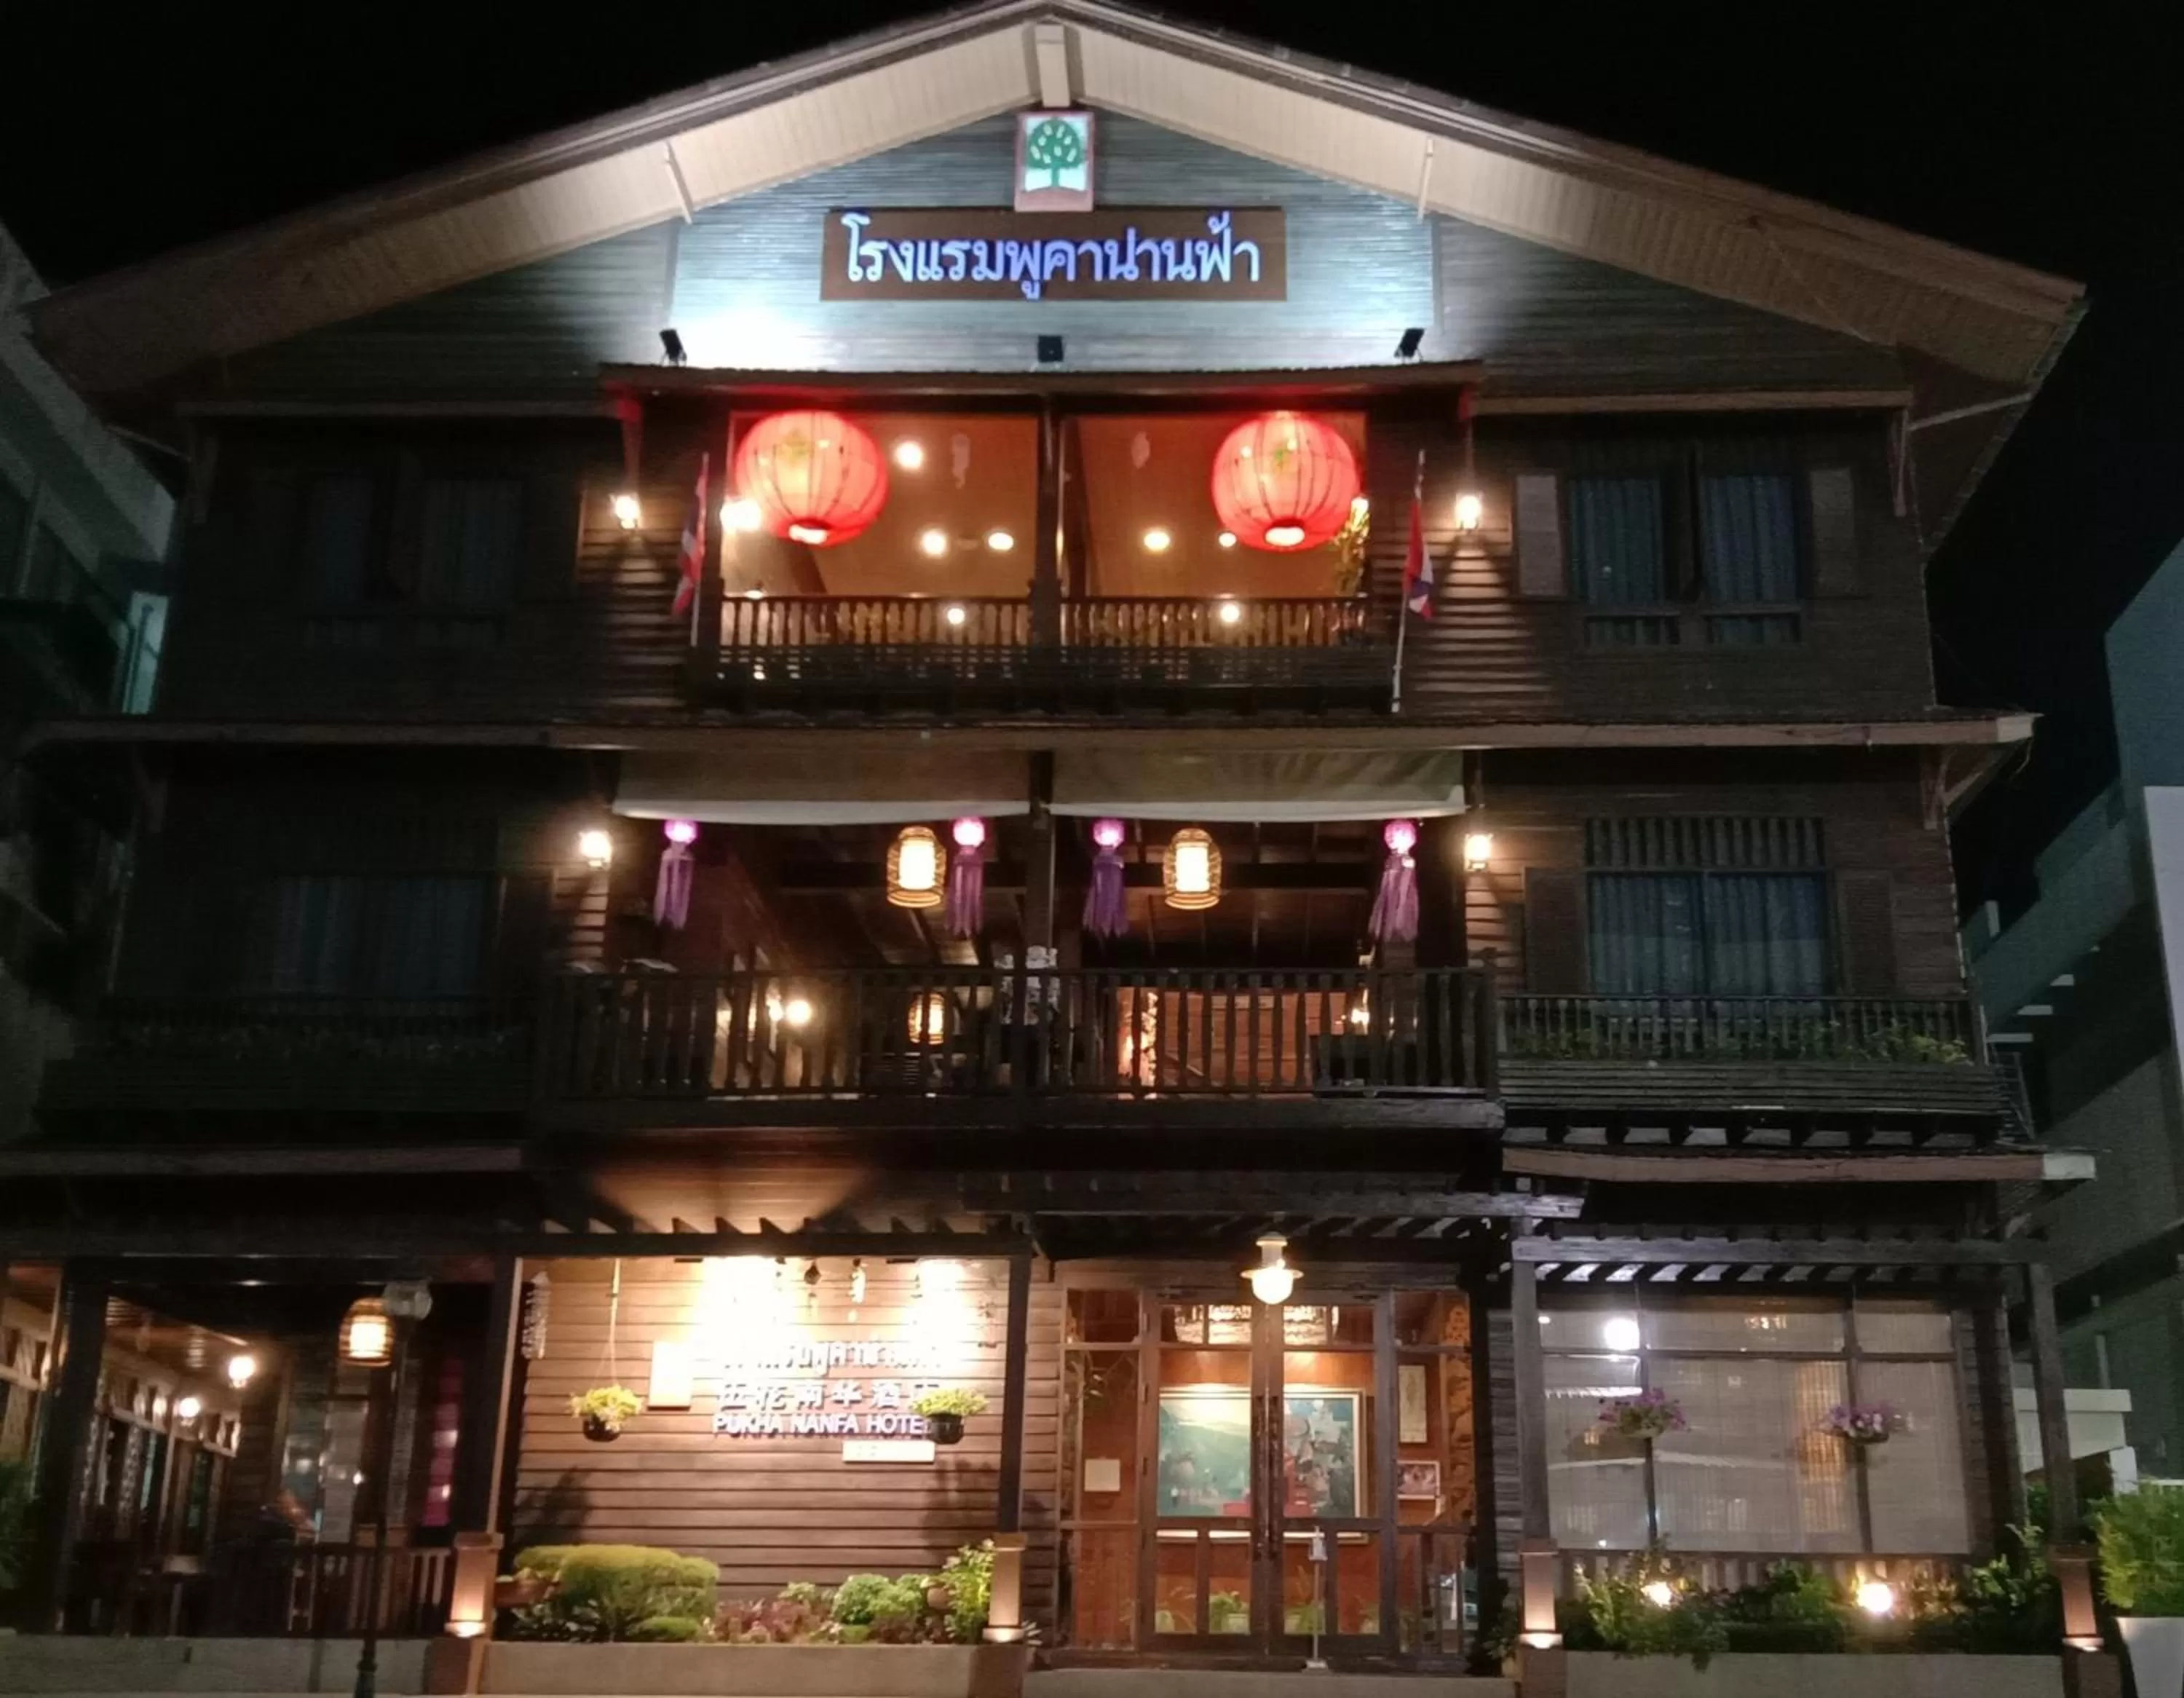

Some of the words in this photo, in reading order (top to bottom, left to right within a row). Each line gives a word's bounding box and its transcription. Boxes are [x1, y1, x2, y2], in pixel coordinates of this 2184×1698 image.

[840, 210, 1260, 301] โรงแรมพูคาน่านฟ้า
[713, 1413, 782, 1434] PUKHA
[790, 1413, 860, 1434] NANFA
